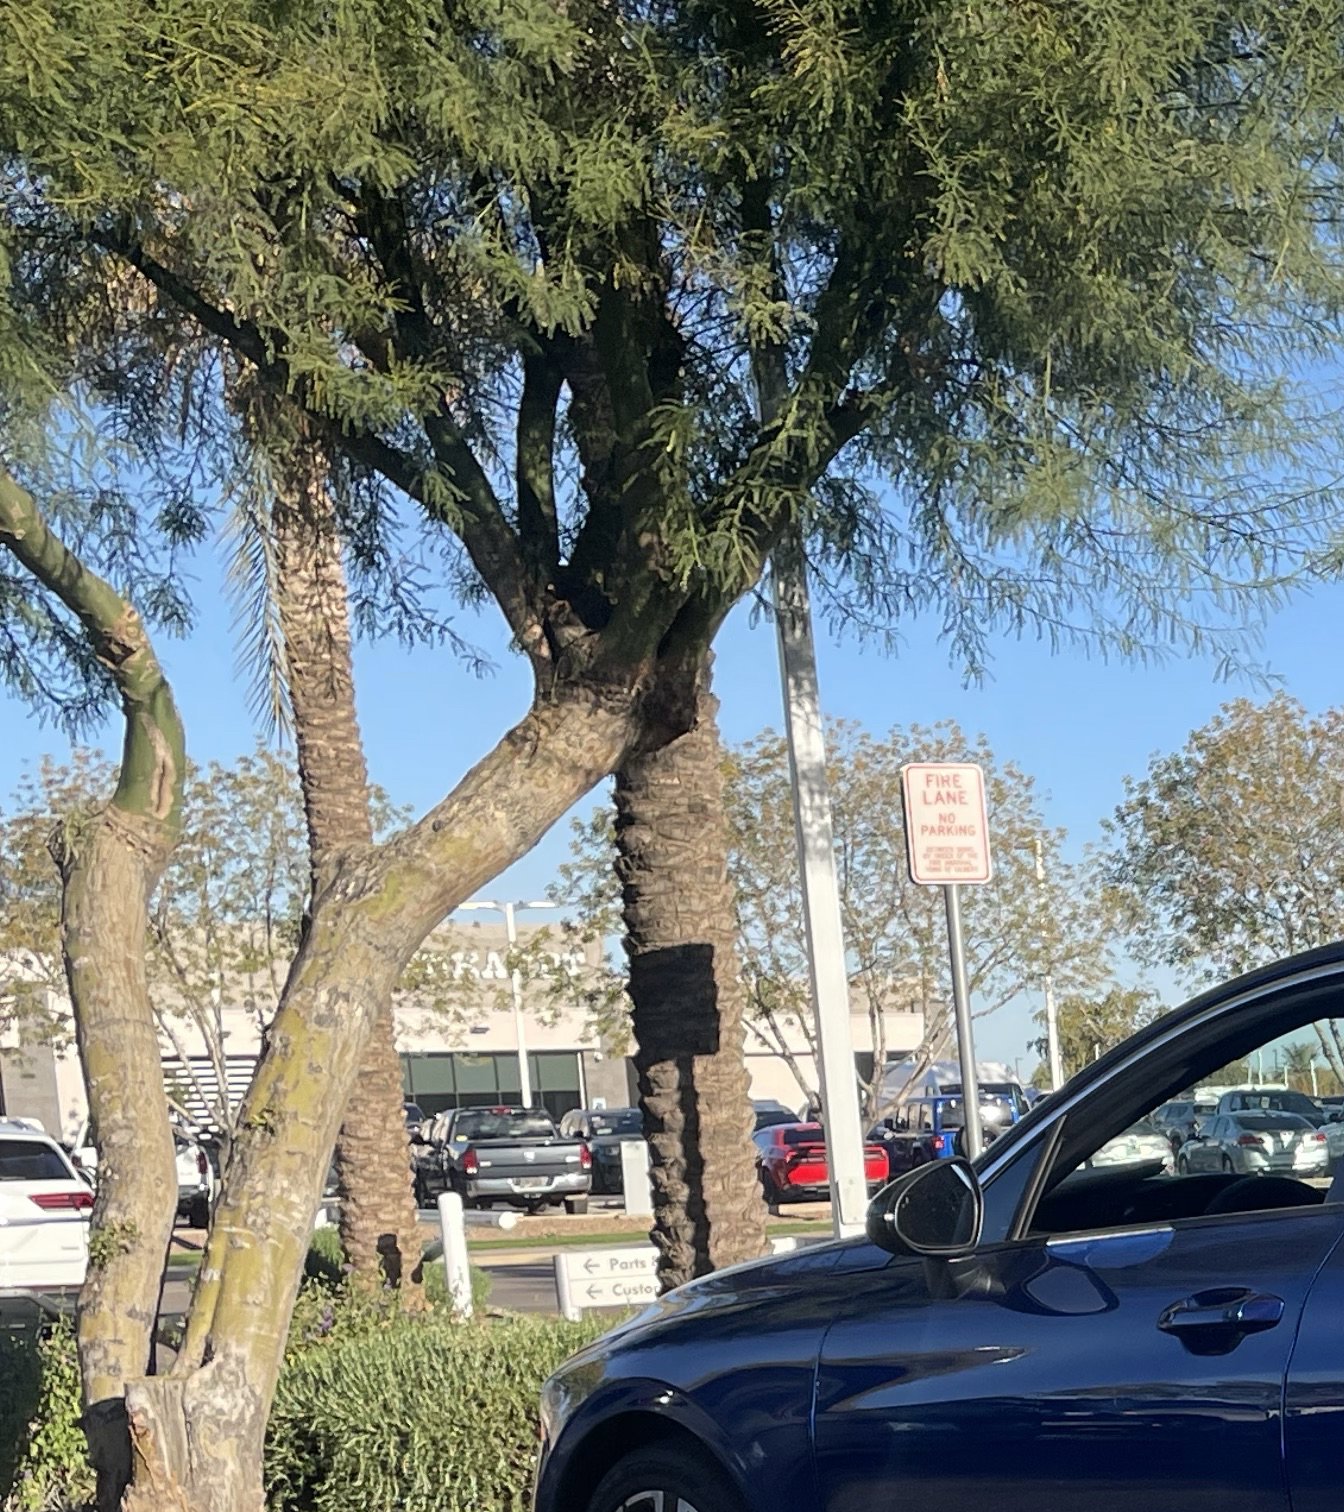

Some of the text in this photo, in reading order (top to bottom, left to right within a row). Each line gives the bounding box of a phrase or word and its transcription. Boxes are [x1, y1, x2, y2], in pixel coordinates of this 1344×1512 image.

[925, 774, 962, 788] FIRE
[922, 790, 968, 806] LANE
[938, 812, 956, 823] NO
[921, 825, 976, 836] PARKING
[609, 1257, 647, 1271] Parts
